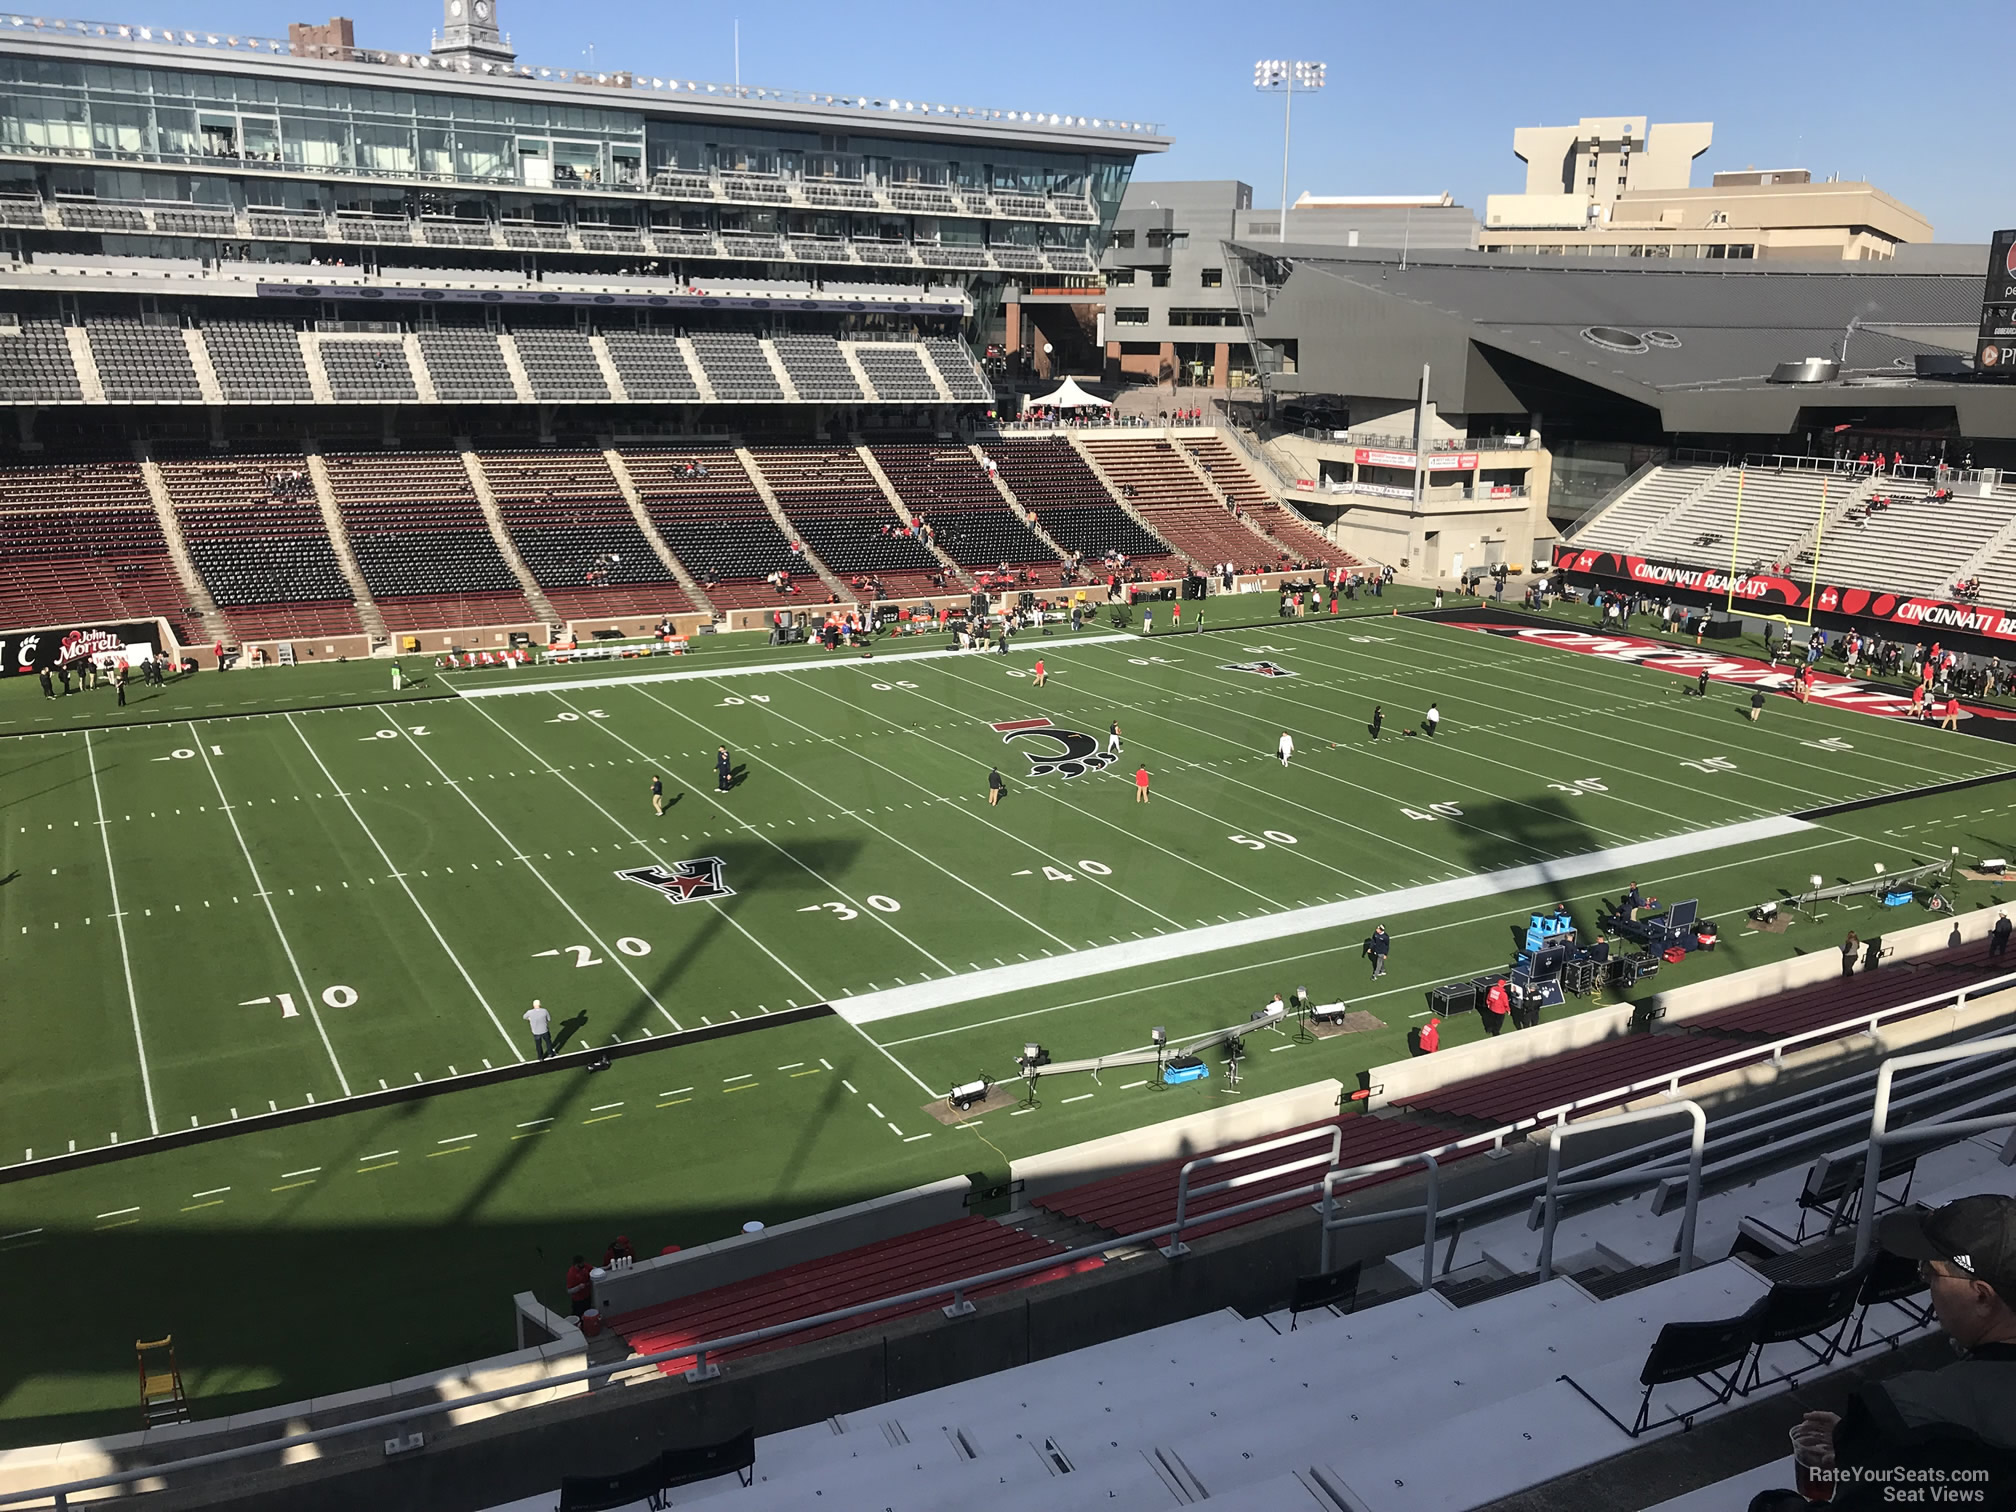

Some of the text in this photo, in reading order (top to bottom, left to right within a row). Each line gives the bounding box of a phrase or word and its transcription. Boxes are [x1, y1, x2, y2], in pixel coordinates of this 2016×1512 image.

[1635, 563, 1768, 597] CINCINNATI BEARCATS
[1897, 603, 1994, 631] CINCINNATI
[78, 629, 108, 644] John
[54, 634, 126, 665] Morrell
[1227, 830, 1298, 850] 50
[1041, 860, 1113, 882] 40
[821, 894, 901, 921] 30
[564, 936, 652, 968] 20
[276, 984, 359, 1019] 10
[1522, 1432, 1532, 1441] 5
[1241, 1452, 1250, 1460] 6
[1394, 1479, 1404, 1488] 6
